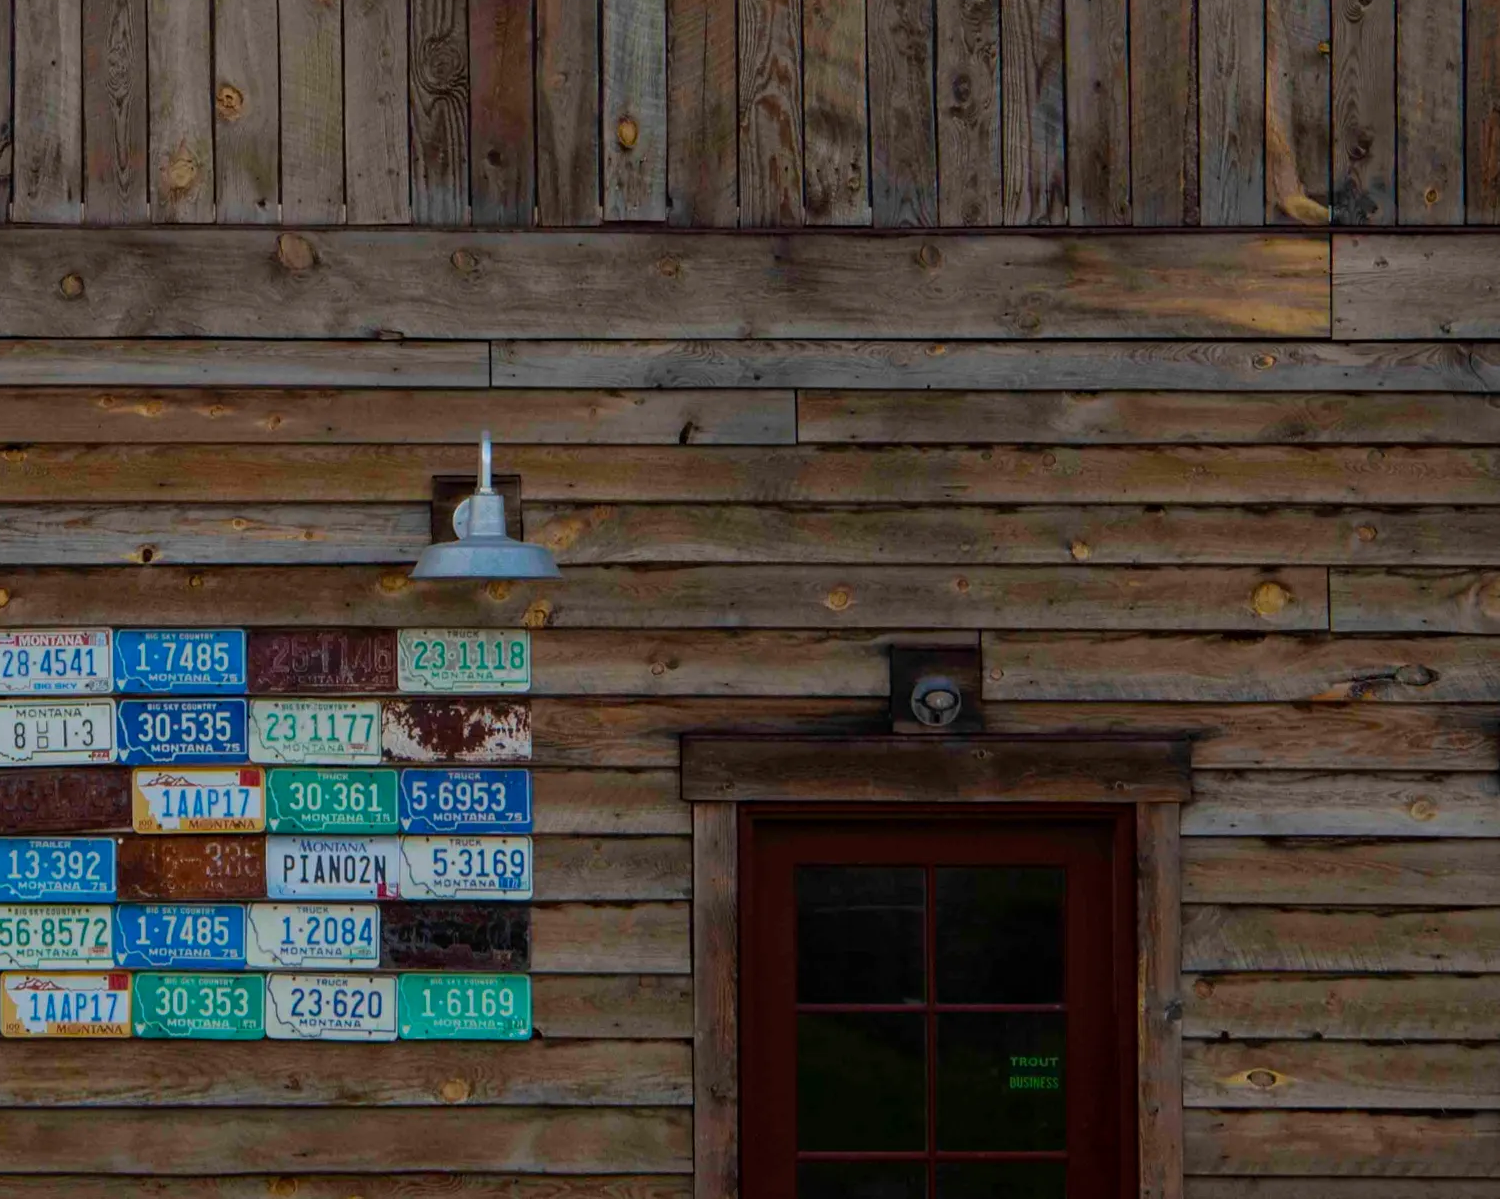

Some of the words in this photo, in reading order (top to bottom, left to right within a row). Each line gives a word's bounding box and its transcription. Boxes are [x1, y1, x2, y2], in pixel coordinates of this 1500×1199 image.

[20, 635, 83, 646] MONTANA
[148, 673, 211, 682] MONTANA
[163, 703, 179, 711] SKY
[181, 703, 217, 711] COUNTRY
[16, 708, 82, 718] MONTANA
[151, 744, 213, 753] MONTANA
[283, 743, 345, 752] MONTANA
[448, 772, 481, 780] TRUCK
[162, 788, 250, 817] 1AAP17
[301, 813, 364, 822] MONTANA
[433, 813, 496, 821] MONTANA
[29, 841, 71, 849] TRAILER
[298, 840, 367, 852] MONTANA
[450, 838, 482, 846] TRUCK
[18, 881, 80, 890] MONTANA
[433, 879, 496, 888] MONTANA
[180, 907, 216, 915] COUNTRY
[16, 948, 78, 957] MONTANA
[148, 948, 211, 957] MONTANA
[280, 947, 342, 955] MONTANA
[316, 978, 348, 986] TRUCK
[30, 992, 118, 1022] 1AAP17
[167, 1018, 229, 1028] MONTANA
[299, 1019, 361, 1027] MONTANA
[1010, 1056, 1059, 1068] TROUT
[1009, 1076, 1059, 1090] BUSINESS
